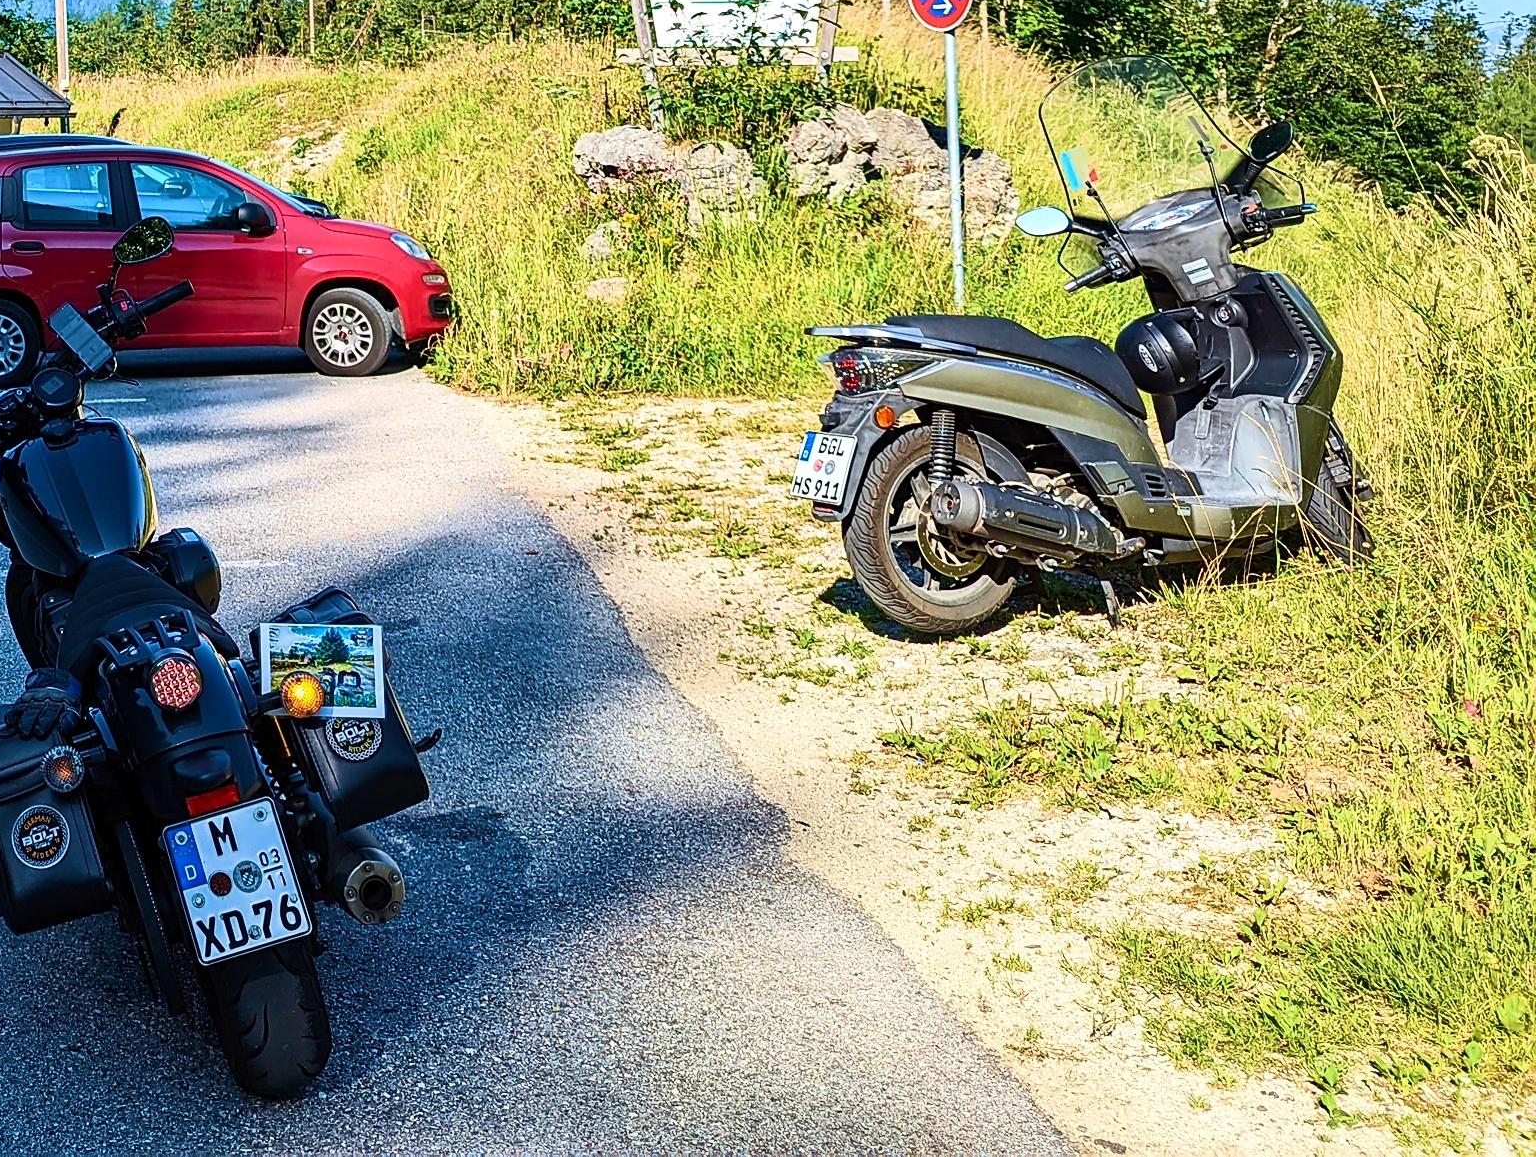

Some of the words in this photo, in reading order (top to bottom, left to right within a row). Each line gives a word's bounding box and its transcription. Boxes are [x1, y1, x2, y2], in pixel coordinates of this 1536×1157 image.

[792, 476, 812, 495] HS
[814, 479, 839, 500] 911
[334, 721, 370, 743] BOLT
[23, 814, 52, 830] GERMAN
[22, 826, 60, 847] BOLT
[208, 816, 238, 856] M
[32, 846, 58, 859] RIDERS
[259, 848, 281, 866] 03
[184, 864, 197, 881] D
[267, 872, 287, 890] 11
[196, 910, 249, 957] XD
[252, 894, 302, 939] 76
